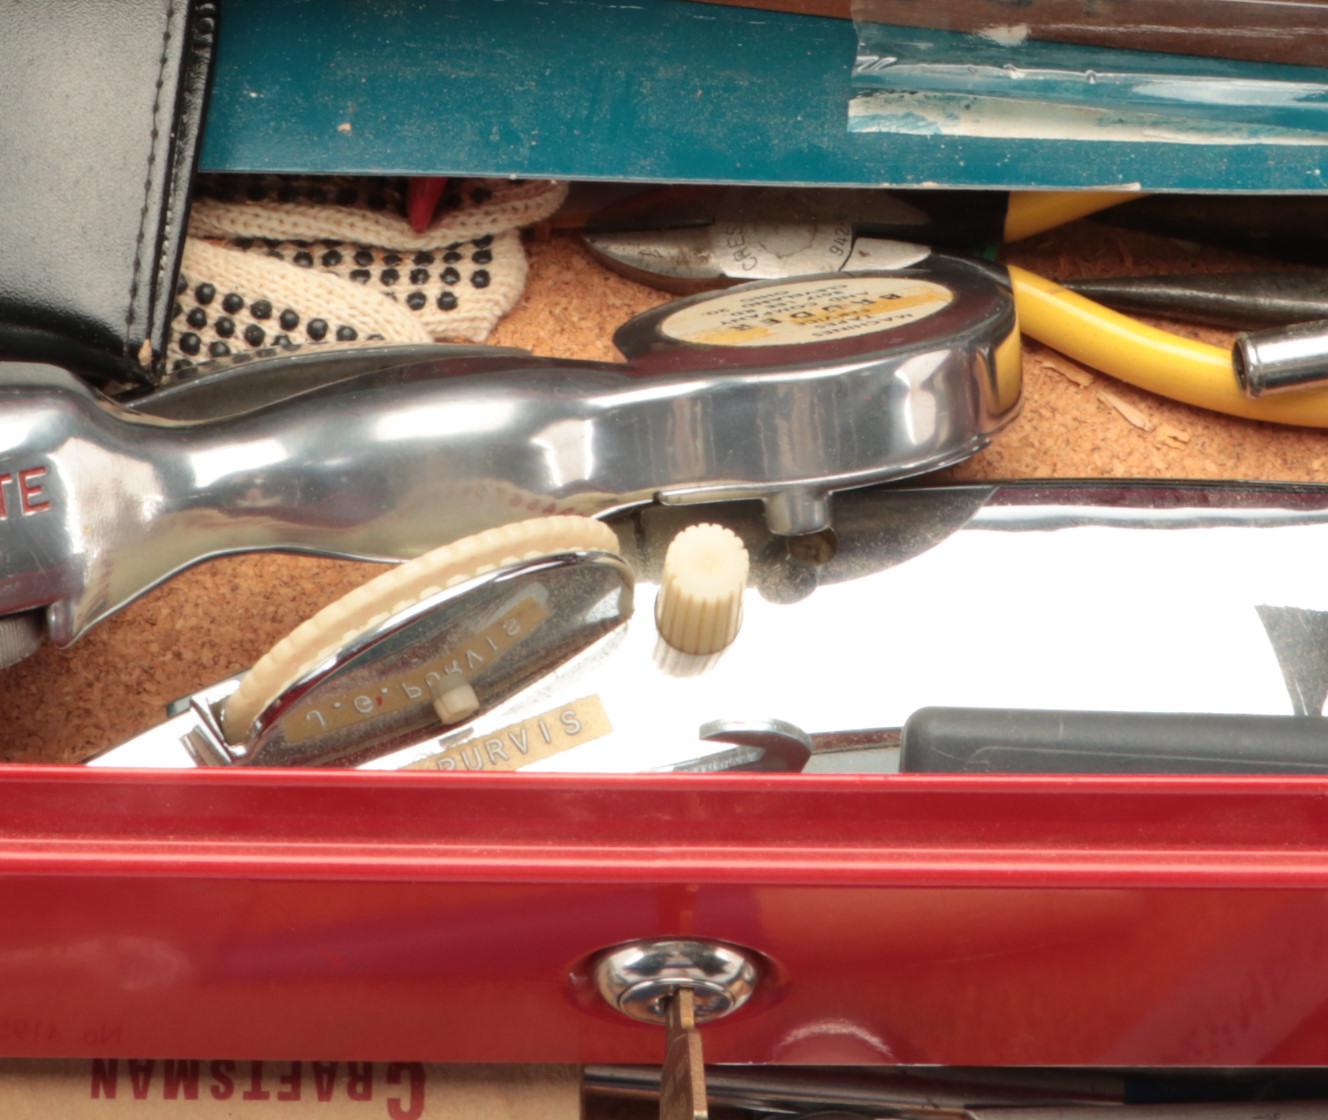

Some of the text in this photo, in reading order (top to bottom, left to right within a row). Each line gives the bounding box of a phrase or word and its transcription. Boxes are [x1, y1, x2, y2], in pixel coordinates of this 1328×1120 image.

[730, 292, 900, 333] BRUDER
[811, 312, 912, 337] MACHINES
[90, 1057, 426, 1120] CRAFTSMAN
